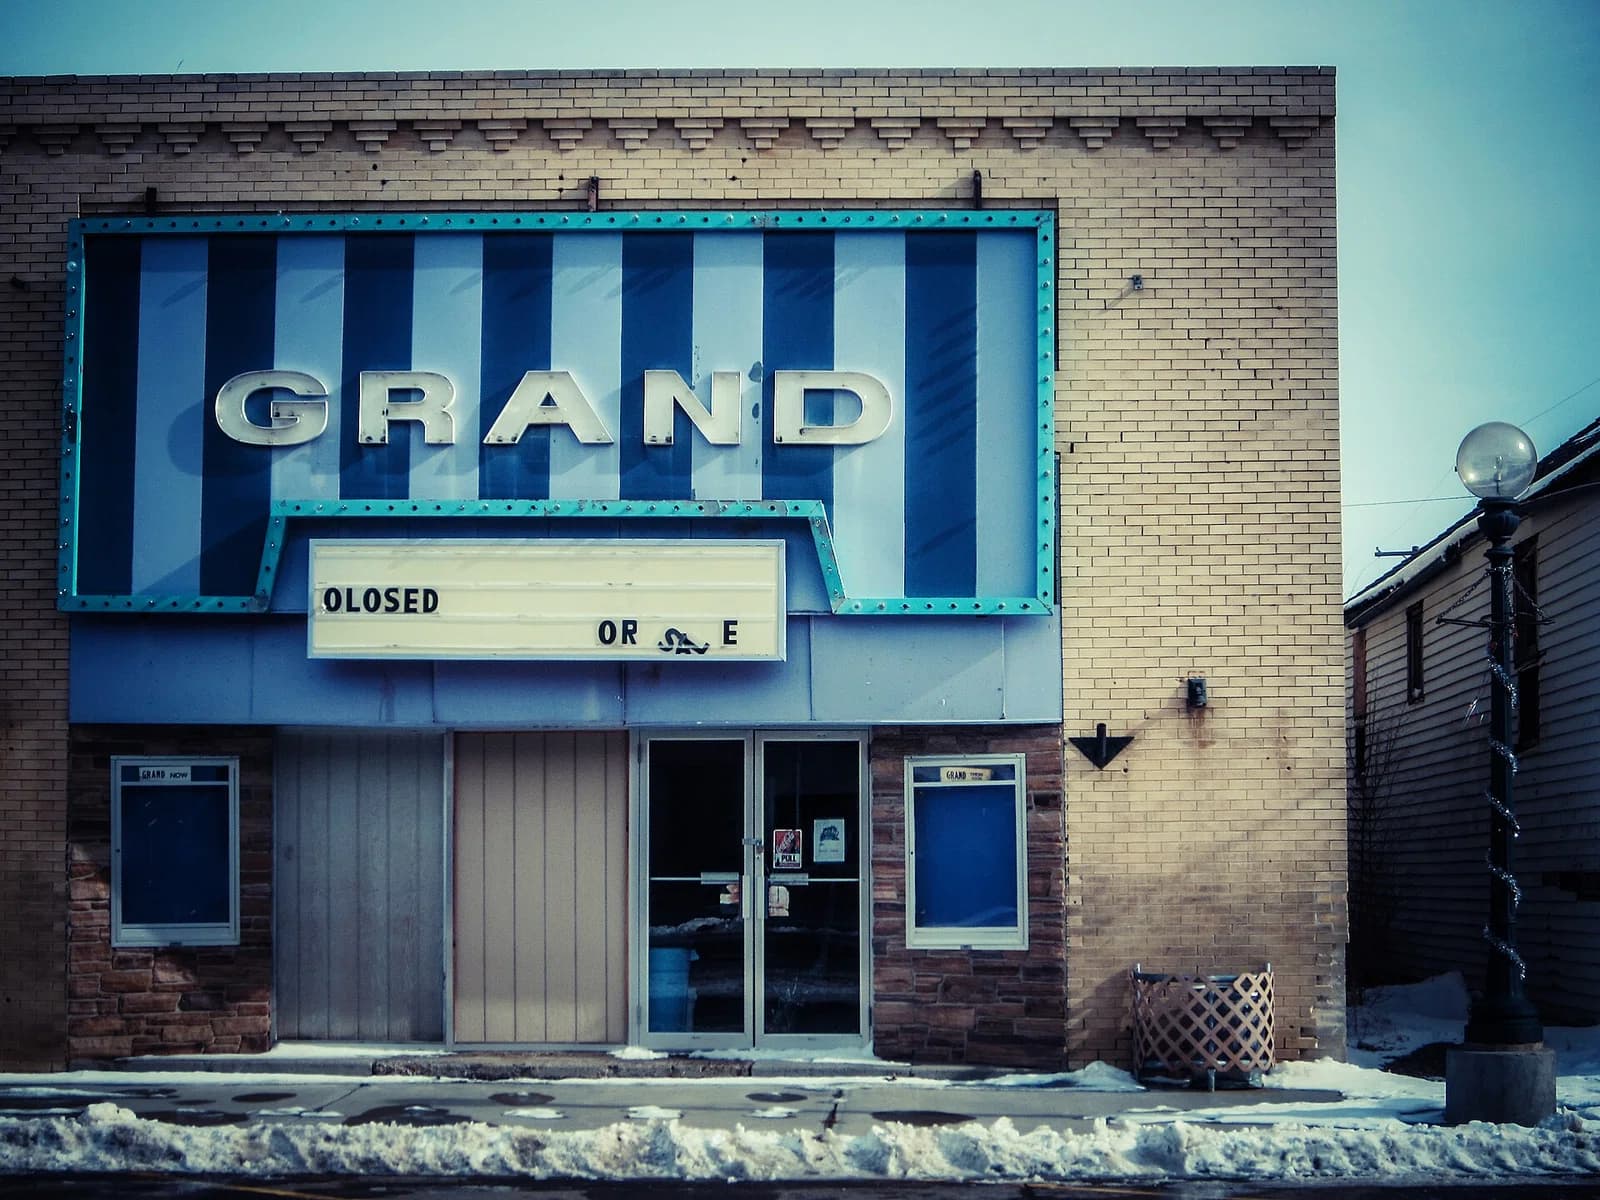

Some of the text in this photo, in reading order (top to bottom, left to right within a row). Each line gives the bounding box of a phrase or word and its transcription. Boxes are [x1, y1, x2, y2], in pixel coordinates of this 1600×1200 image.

[214, 370, 894, 447] GRAND
[598, 619, 638, 645] OR
[141, 769, 166, 780] GRAND
[946, 770, 967, 780] GRAND
[781, 854, 797, 862] PULL
